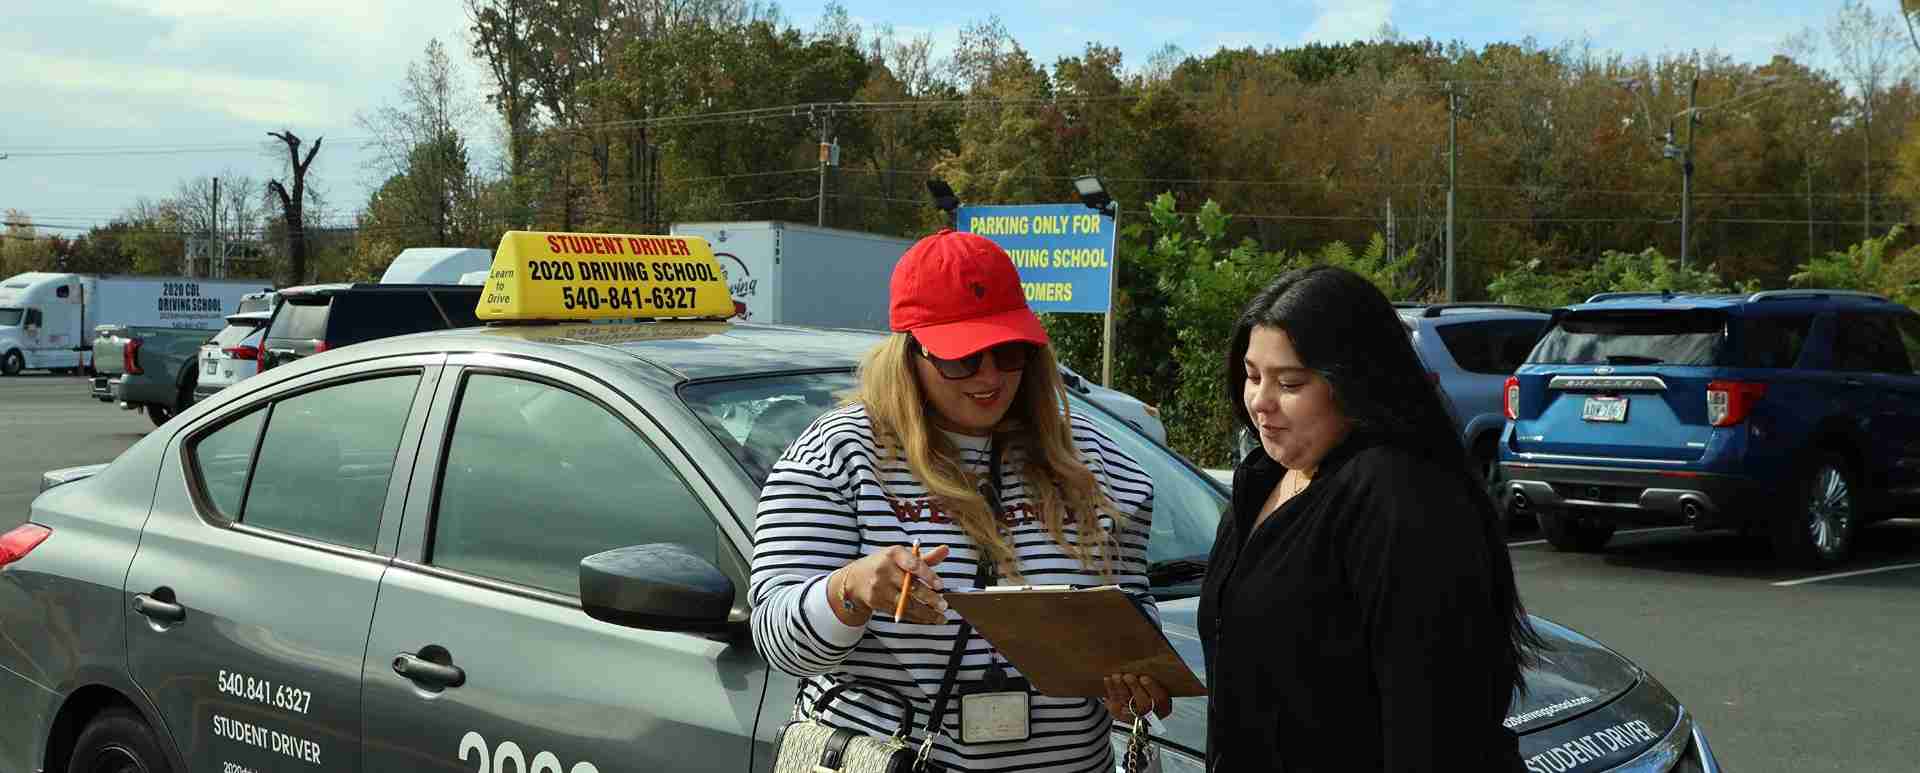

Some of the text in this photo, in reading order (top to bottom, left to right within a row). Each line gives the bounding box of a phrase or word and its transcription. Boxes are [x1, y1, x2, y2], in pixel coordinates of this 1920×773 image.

[970, 215, 1101, 235] PARKING ONLY FOR
[547, 235, 690, 256] STUDENT DRIVER
[1008, 249, 1108, 268] IVING SCHOOL
[490, 269, 514, 279] Learn
[528, 261, 575, 281] 2020
[578, 261, 648, 281] DRIVING
[652, 262, 718, 282] SCHOOL
[163, 283, 184, 297] 2020
[496, 281, 504, 291] to
[1022, 283, 1072, 301] TOMERS
[158, 297, 221, 311] DRIVING SCHOOL
[487, 294, 510, 304] Drive
[563, 286, 697, 310] 540-841-6327
[218, 669, 311, 714] 540.841.6327
[213, 715, 320, 764] STUDENT DRIVER
[1524, 720, 1659, 773] STUDENT DRIVER
